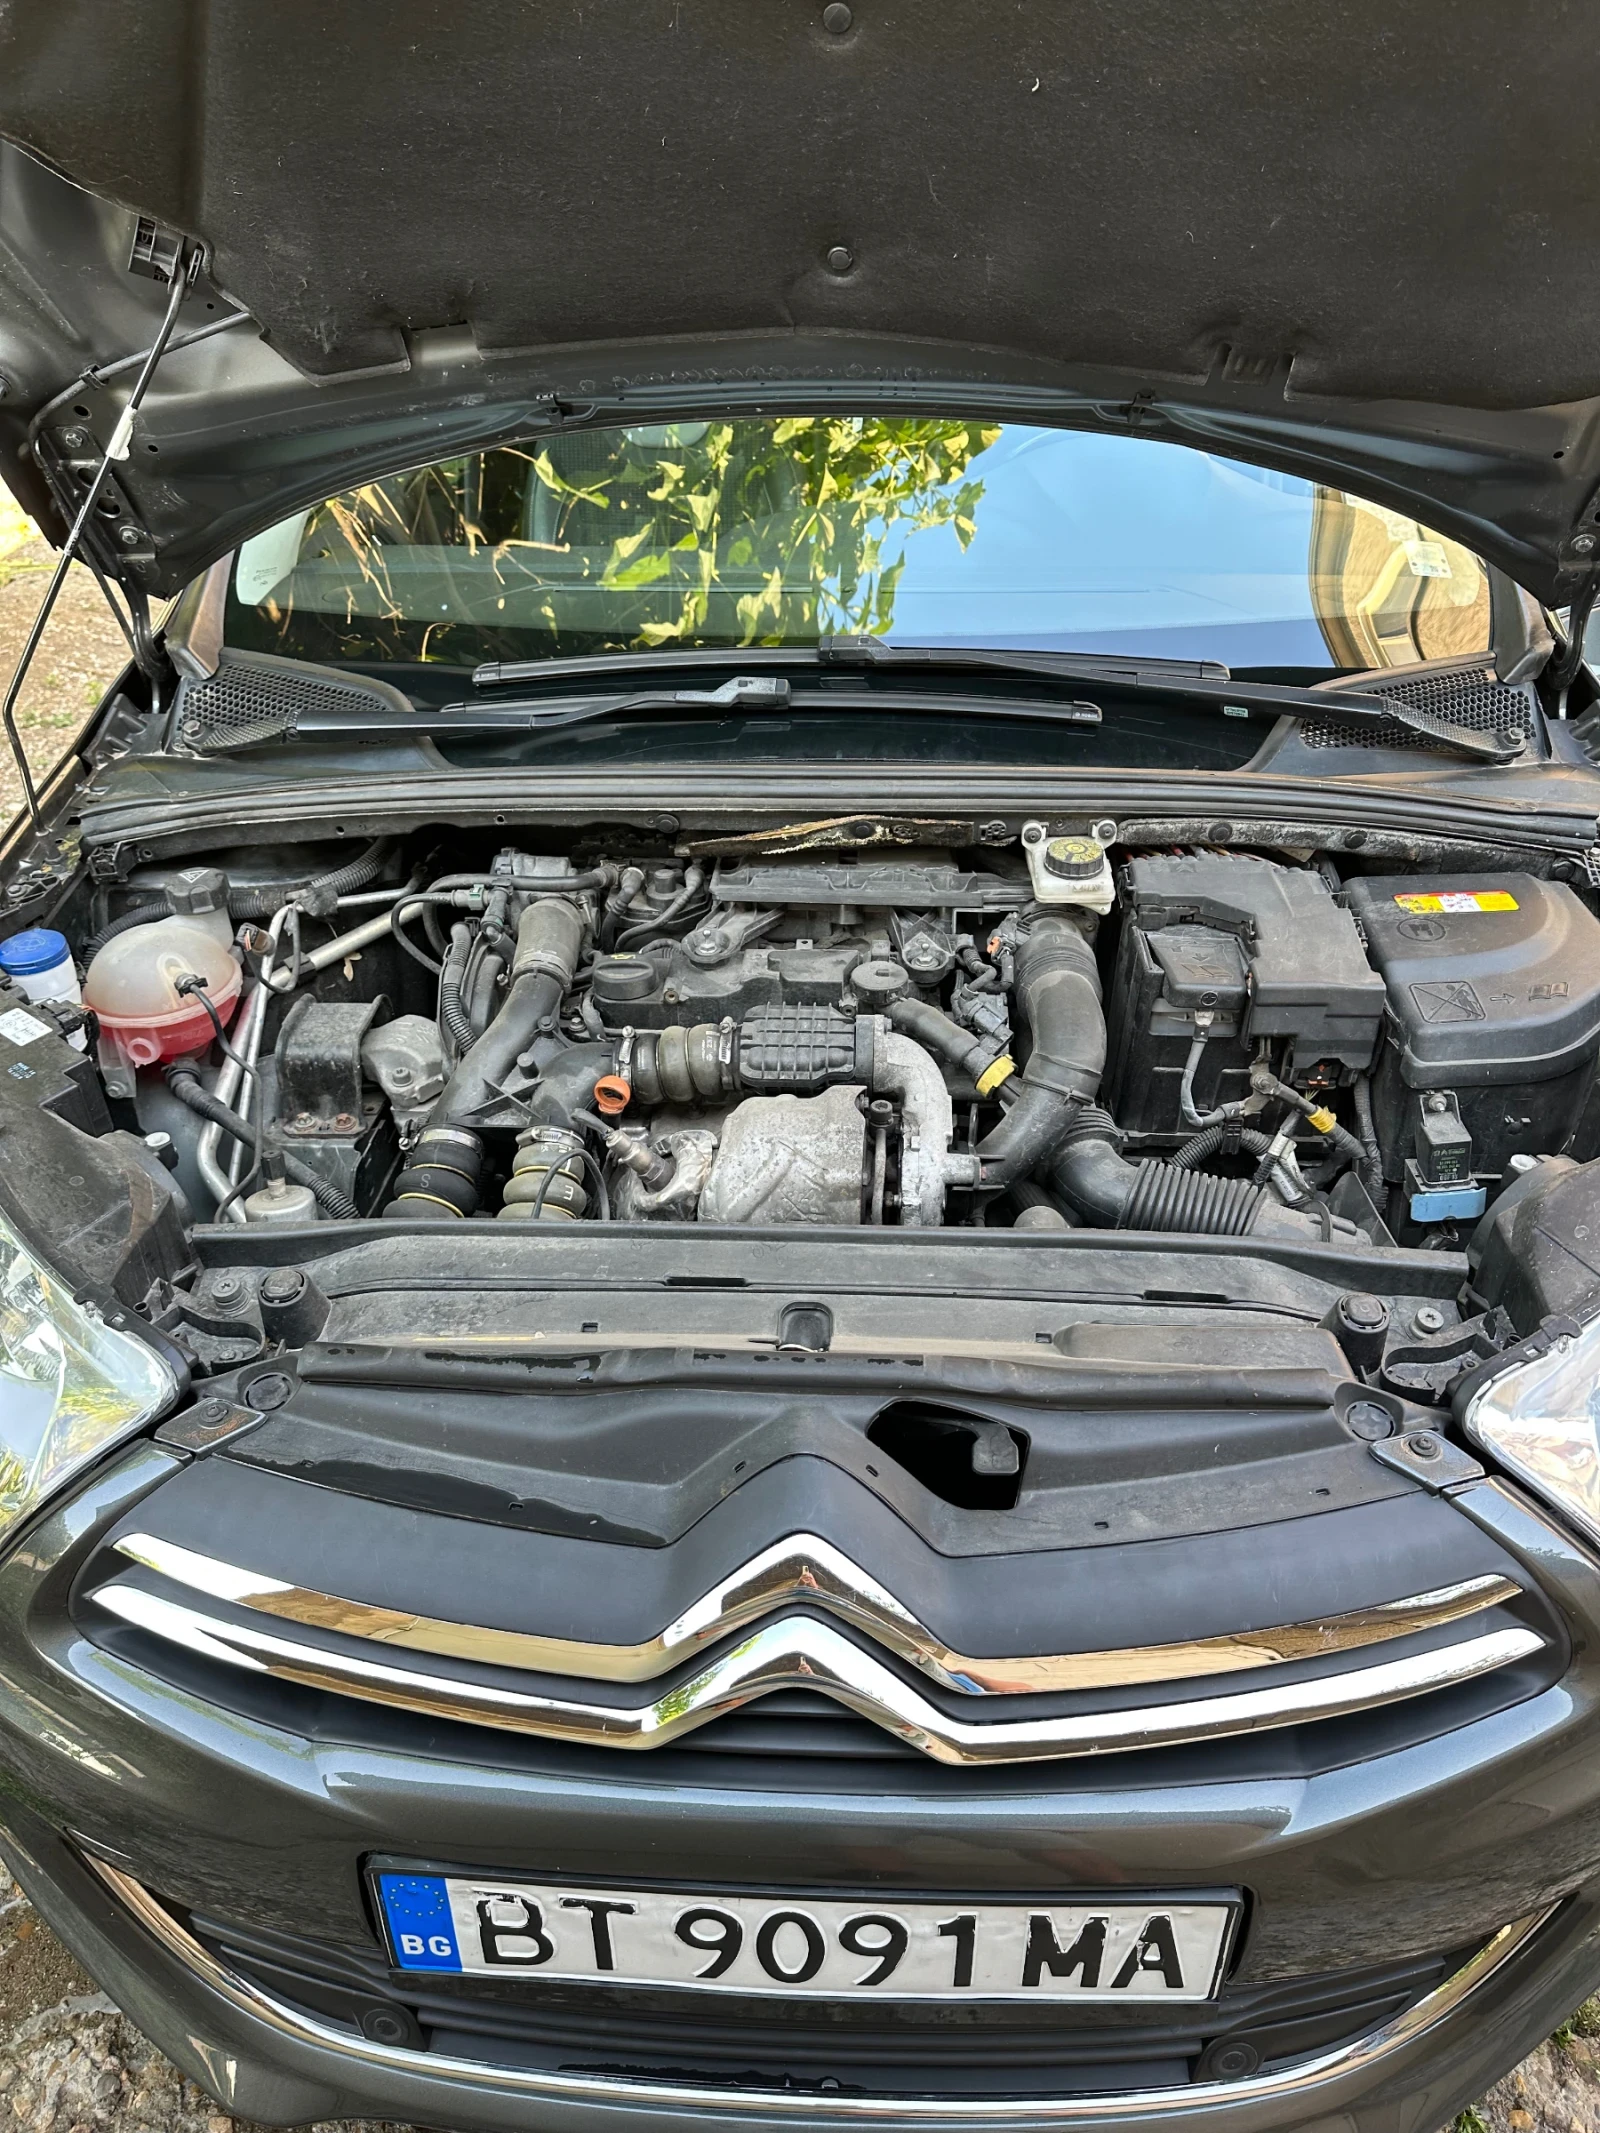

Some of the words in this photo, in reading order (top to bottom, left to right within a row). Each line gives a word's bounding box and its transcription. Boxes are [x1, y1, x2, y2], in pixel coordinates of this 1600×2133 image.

[400, 1934, 452, 1957] BG
[473, 1888, 639, 1971] BT
[673, 1905, 978, 1987] 9091
[1021, 1912, 1185, 1989] MA
